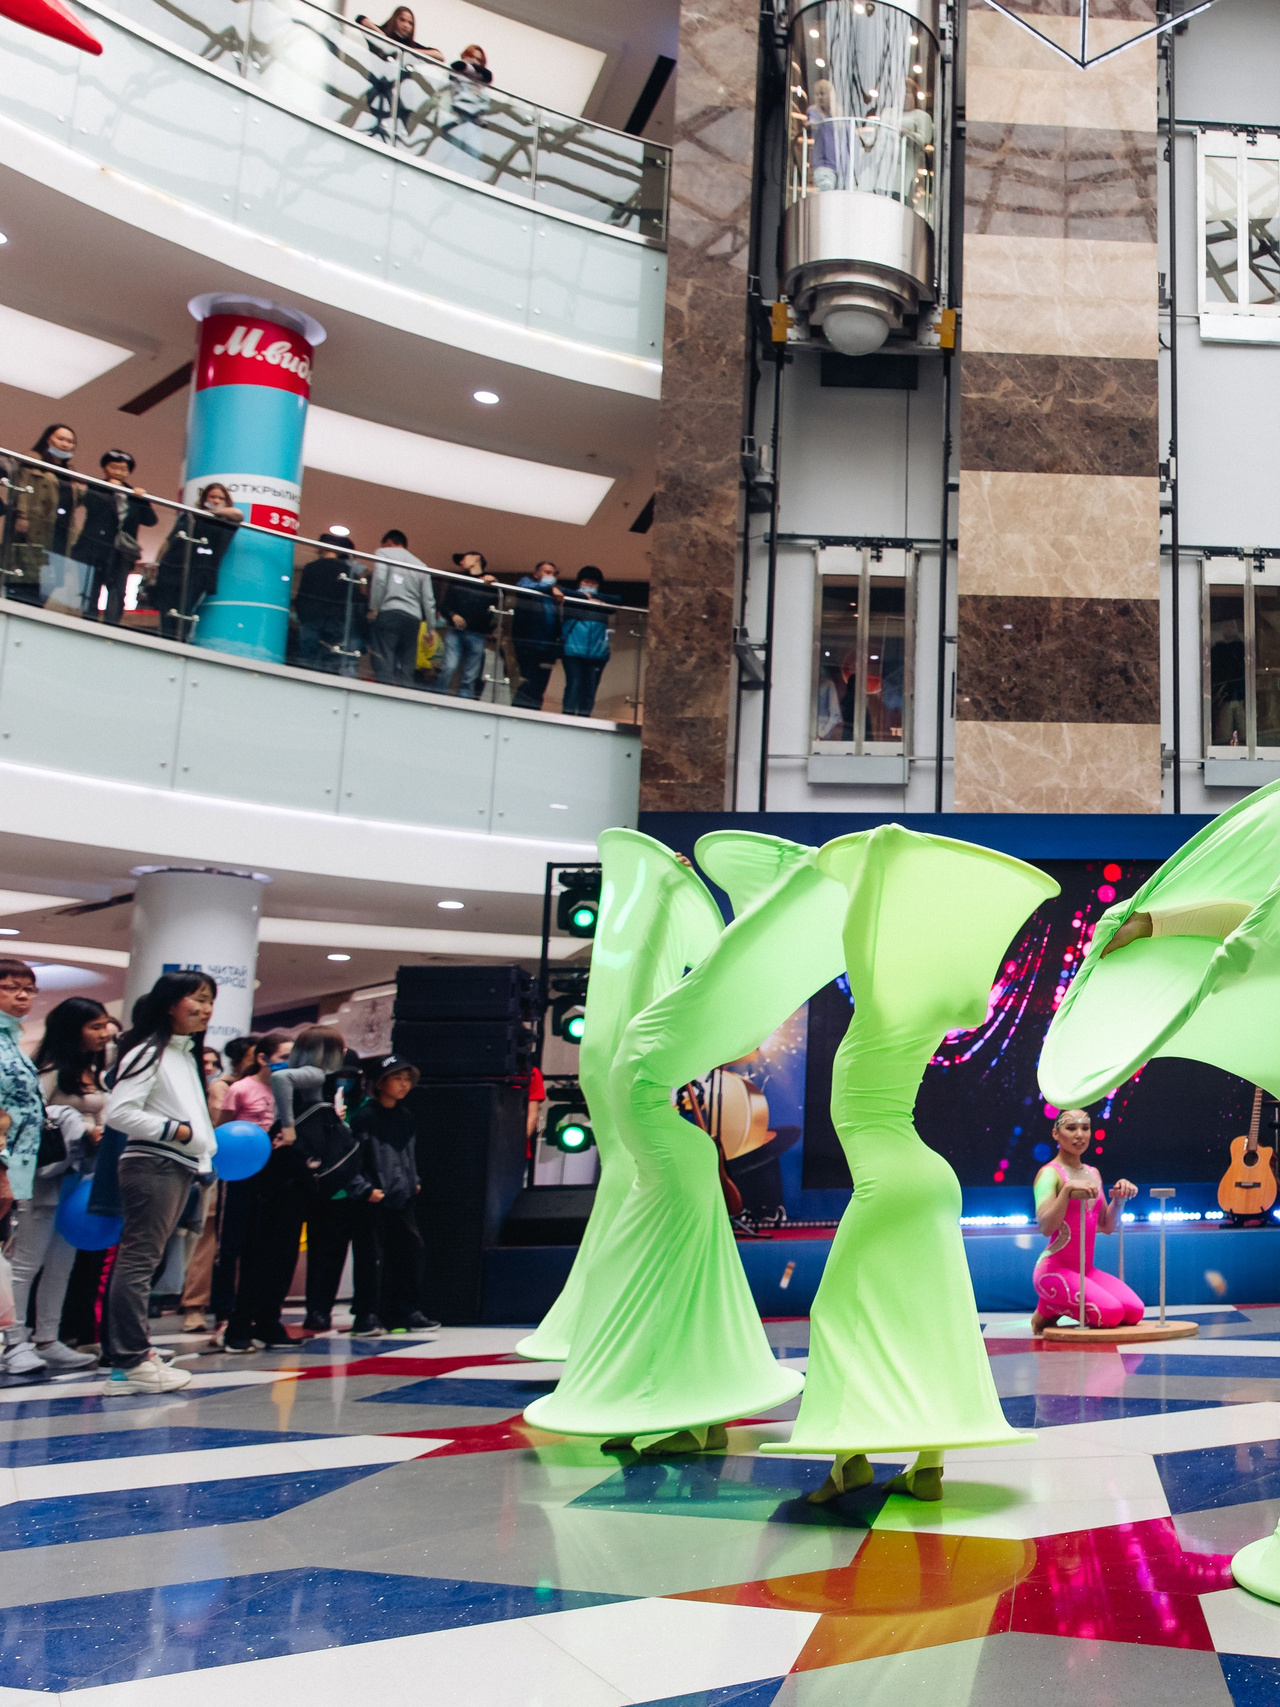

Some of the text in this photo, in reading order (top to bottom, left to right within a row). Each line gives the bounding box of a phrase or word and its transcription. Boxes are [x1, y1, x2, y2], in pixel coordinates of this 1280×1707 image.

[213, 325, 311, 385] М.вид
[269, 512, 280, 525] 3
[207, 964, 248, 977] ЧИТАЙ
[213, 975, 248, 989] ОРОД
